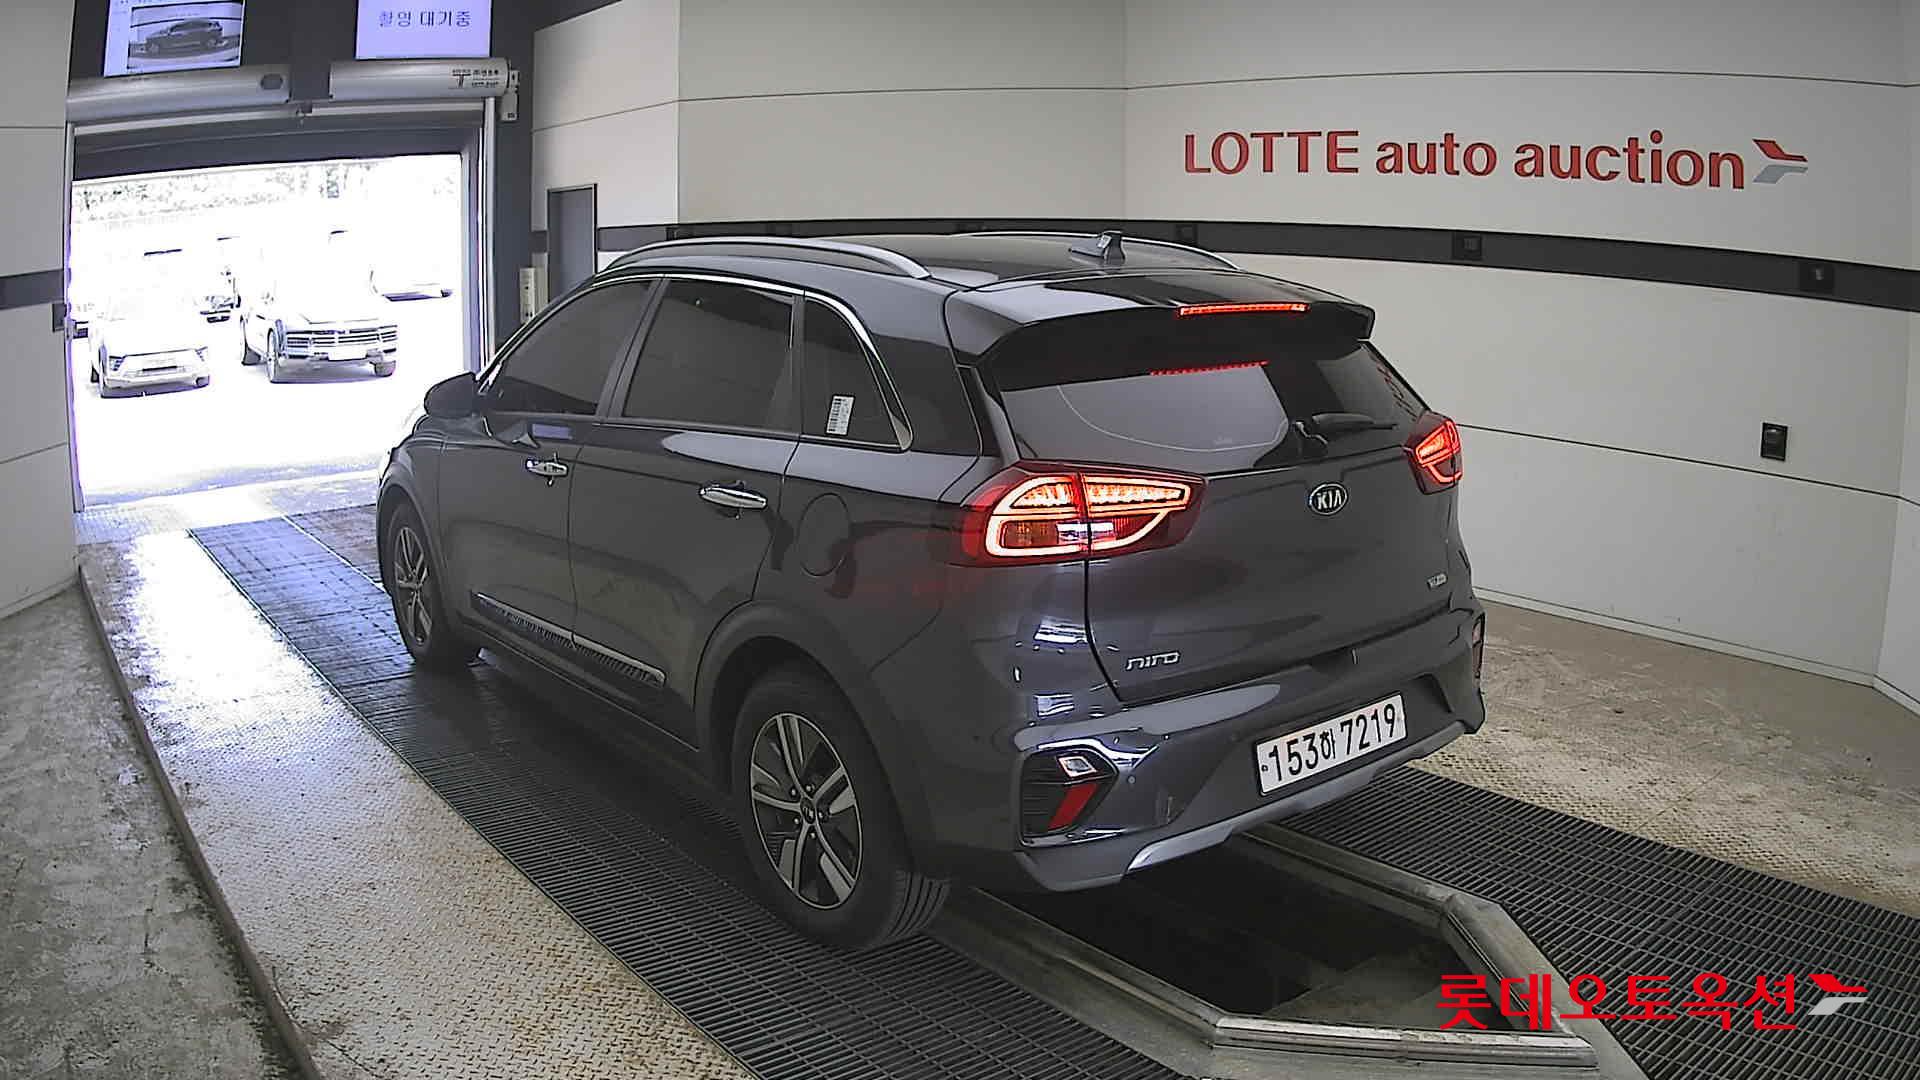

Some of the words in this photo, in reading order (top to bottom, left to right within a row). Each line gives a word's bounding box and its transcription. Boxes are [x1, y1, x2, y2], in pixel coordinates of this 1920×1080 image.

[420, 10, 471, 28] 대기중
[1184, 130, 1360, 174] LOTTE
[1376, 132, 1497, 177] auto
[1514, 130, 1745, 189] auction
[1316, 489, 1342, 510] KIA
[1340, 703, 1396, 755] 7219
